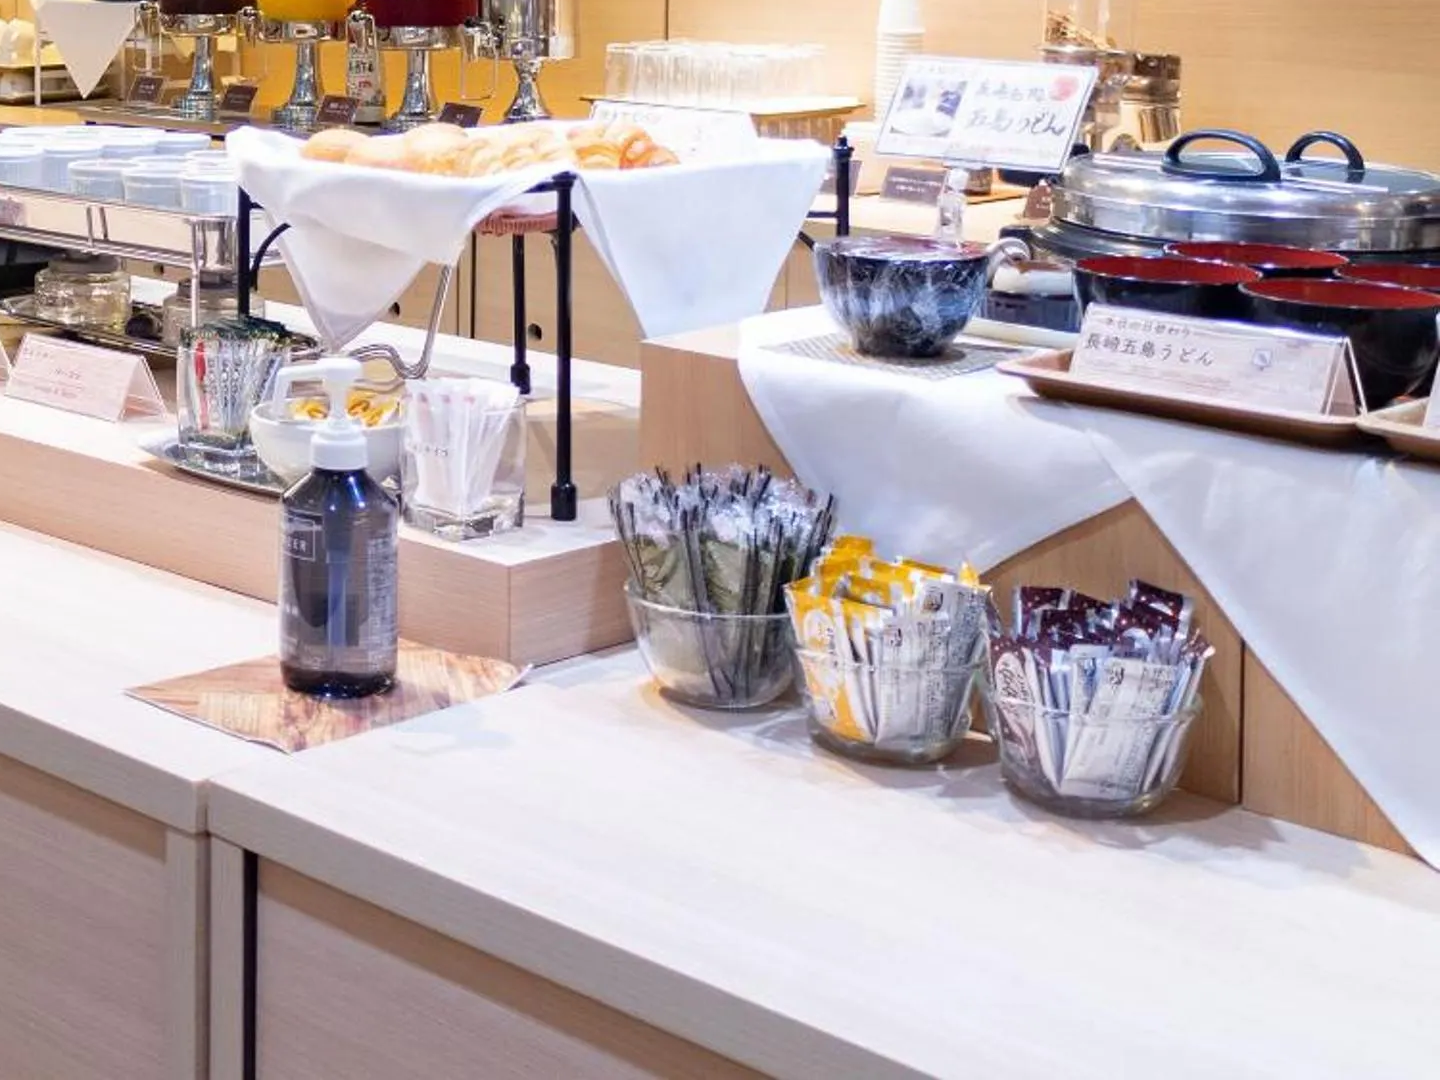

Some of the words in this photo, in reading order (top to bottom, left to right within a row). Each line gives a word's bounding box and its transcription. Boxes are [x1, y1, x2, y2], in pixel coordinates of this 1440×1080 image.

[1085, 331, 1214, 367] 長崎五島うどん
